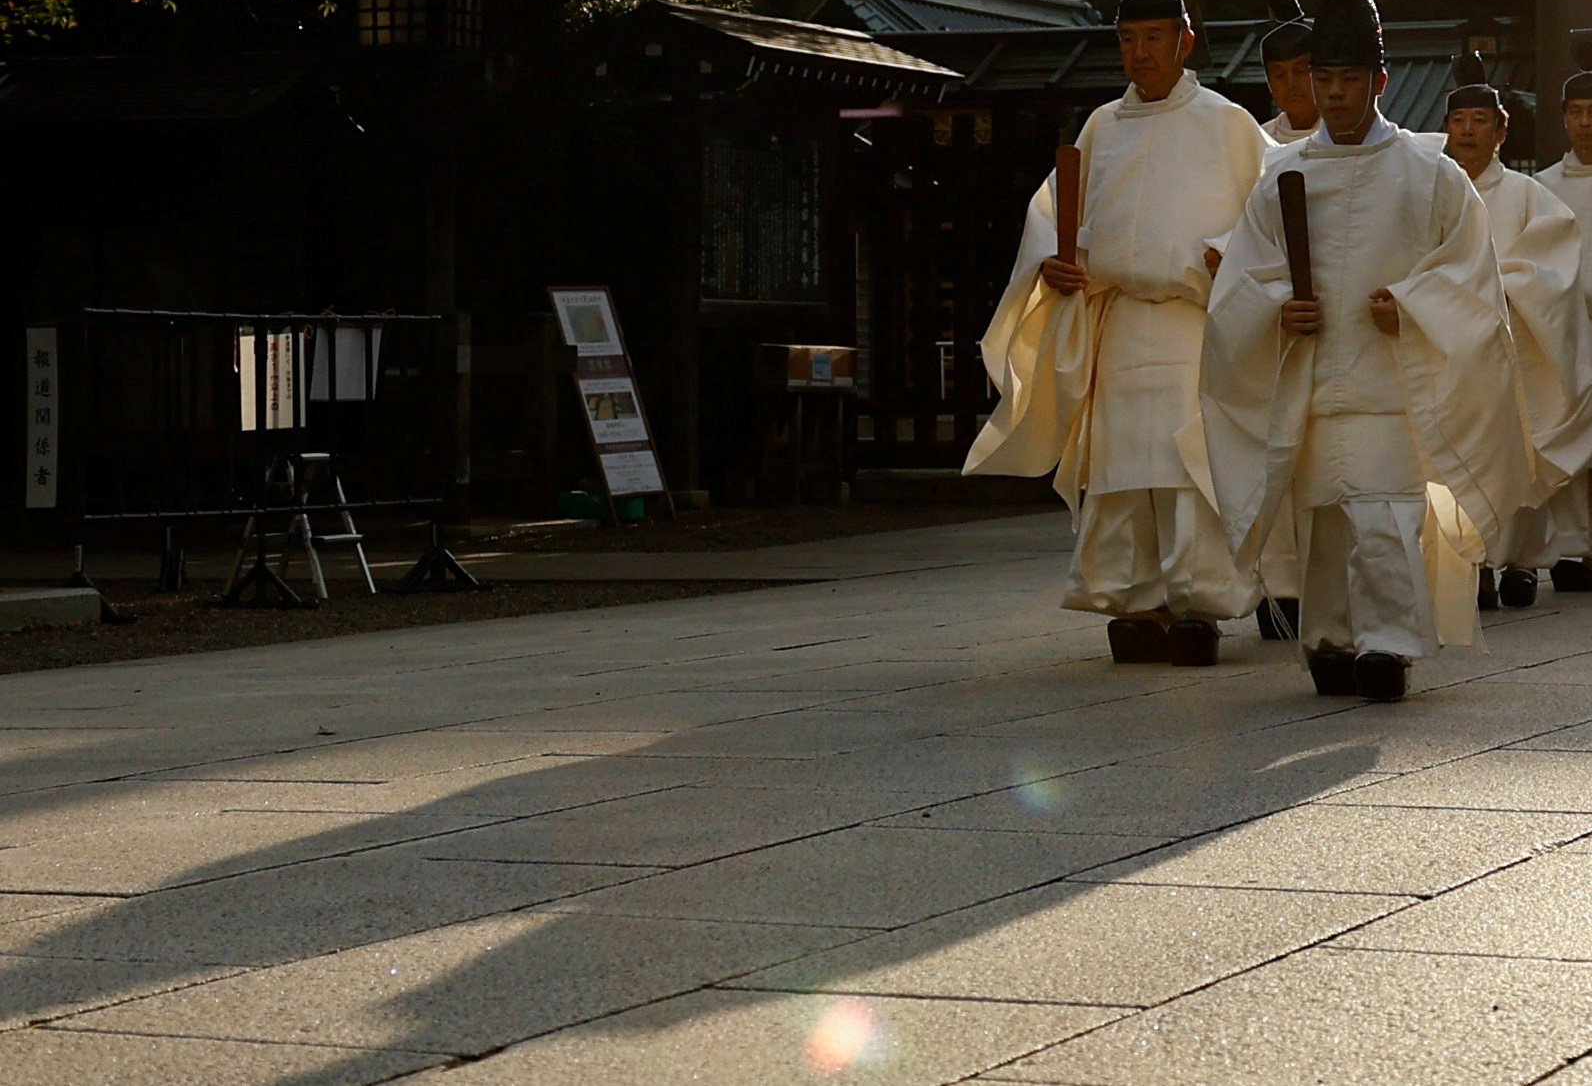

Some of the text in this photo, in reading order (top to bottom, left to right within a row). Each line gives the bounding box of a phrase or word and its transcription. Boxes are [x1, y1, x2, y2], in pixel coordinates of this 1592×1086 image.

[33, 349, 51, 485] 報道関係者
